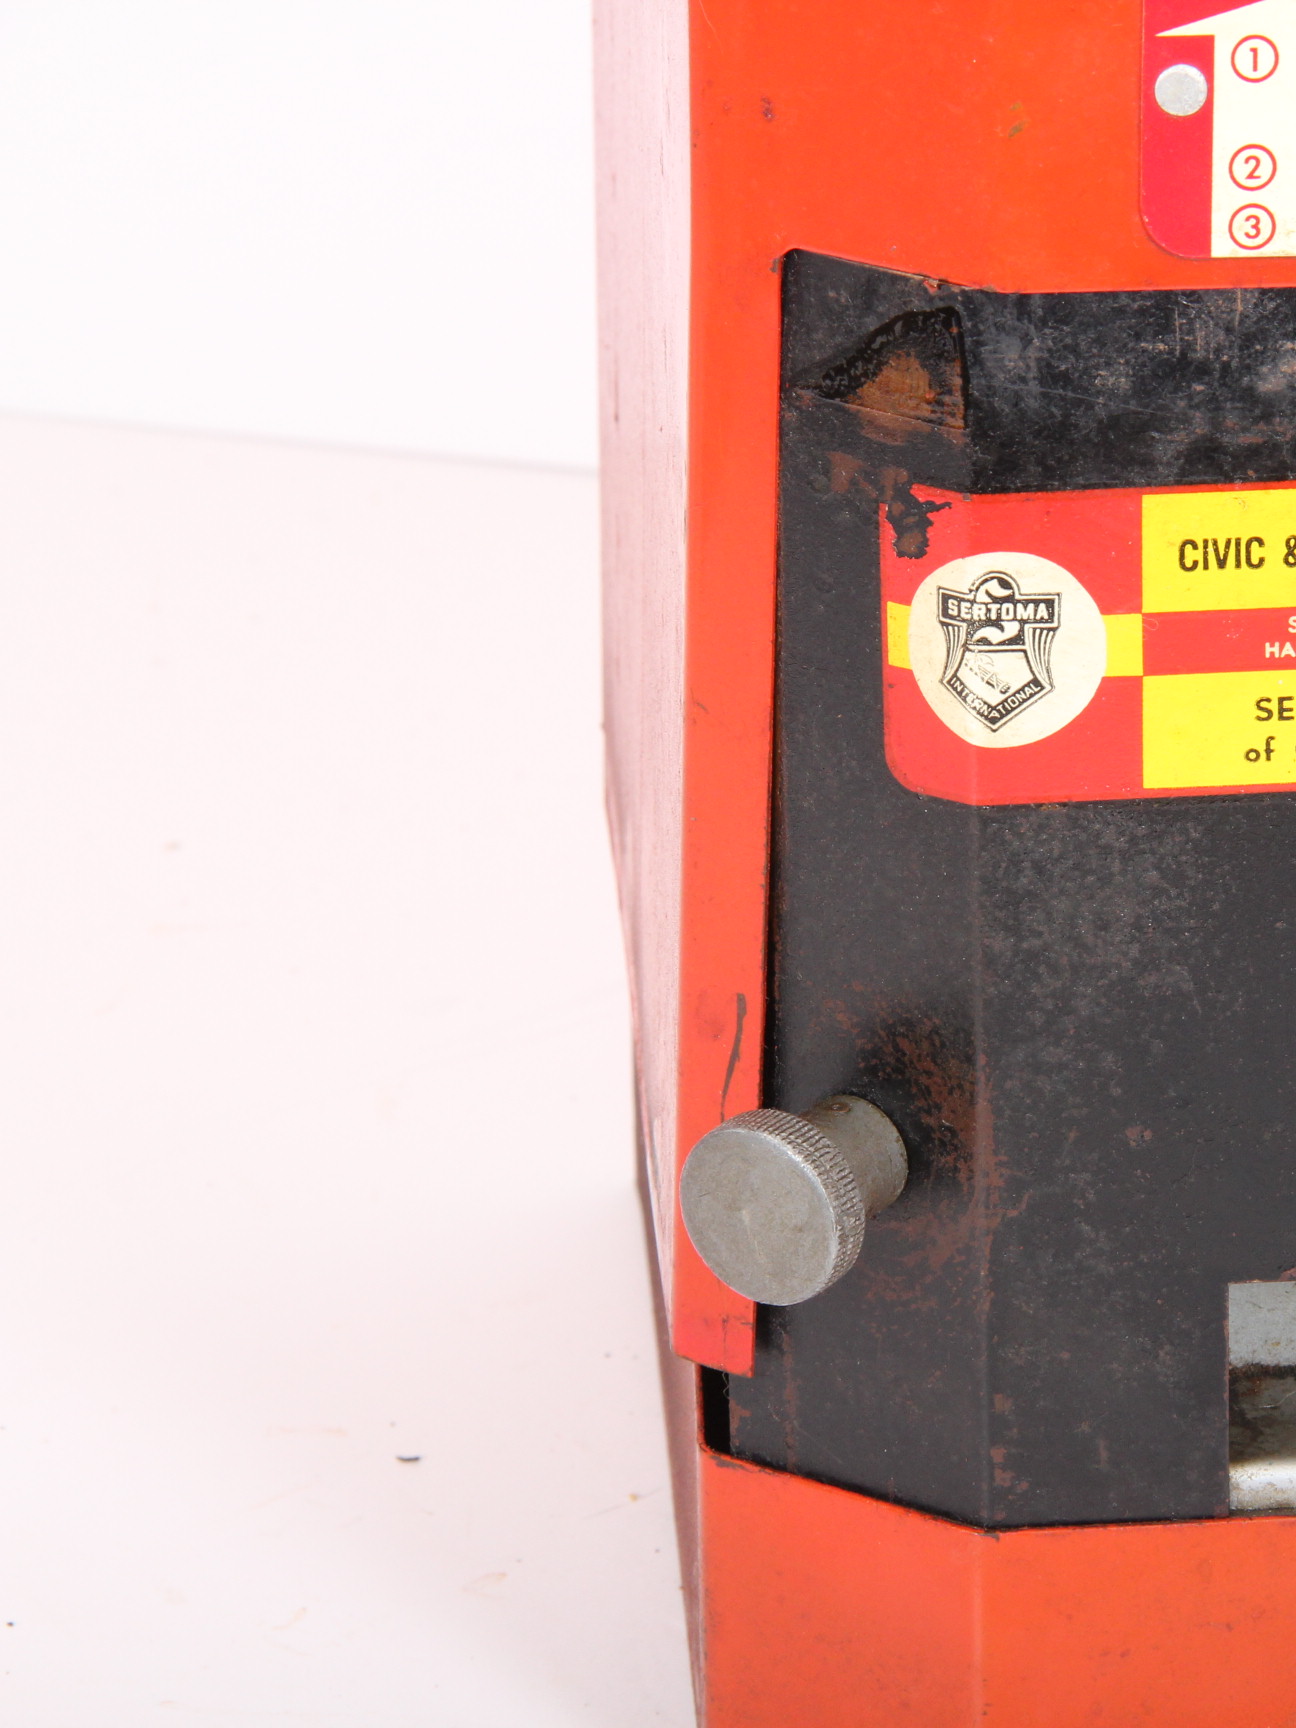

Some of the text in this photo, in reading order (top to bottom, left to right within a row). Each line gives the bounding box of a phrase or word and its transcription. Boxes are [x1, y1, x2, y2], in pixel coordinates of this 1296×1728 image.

[1179, 538, 1264, 571] CIVIC
[948, 599, 1048, 620] SERTOMA
[950, 677, 1041, 718] INTERNATIONAL
[1246, 737, 1274, 761] of
